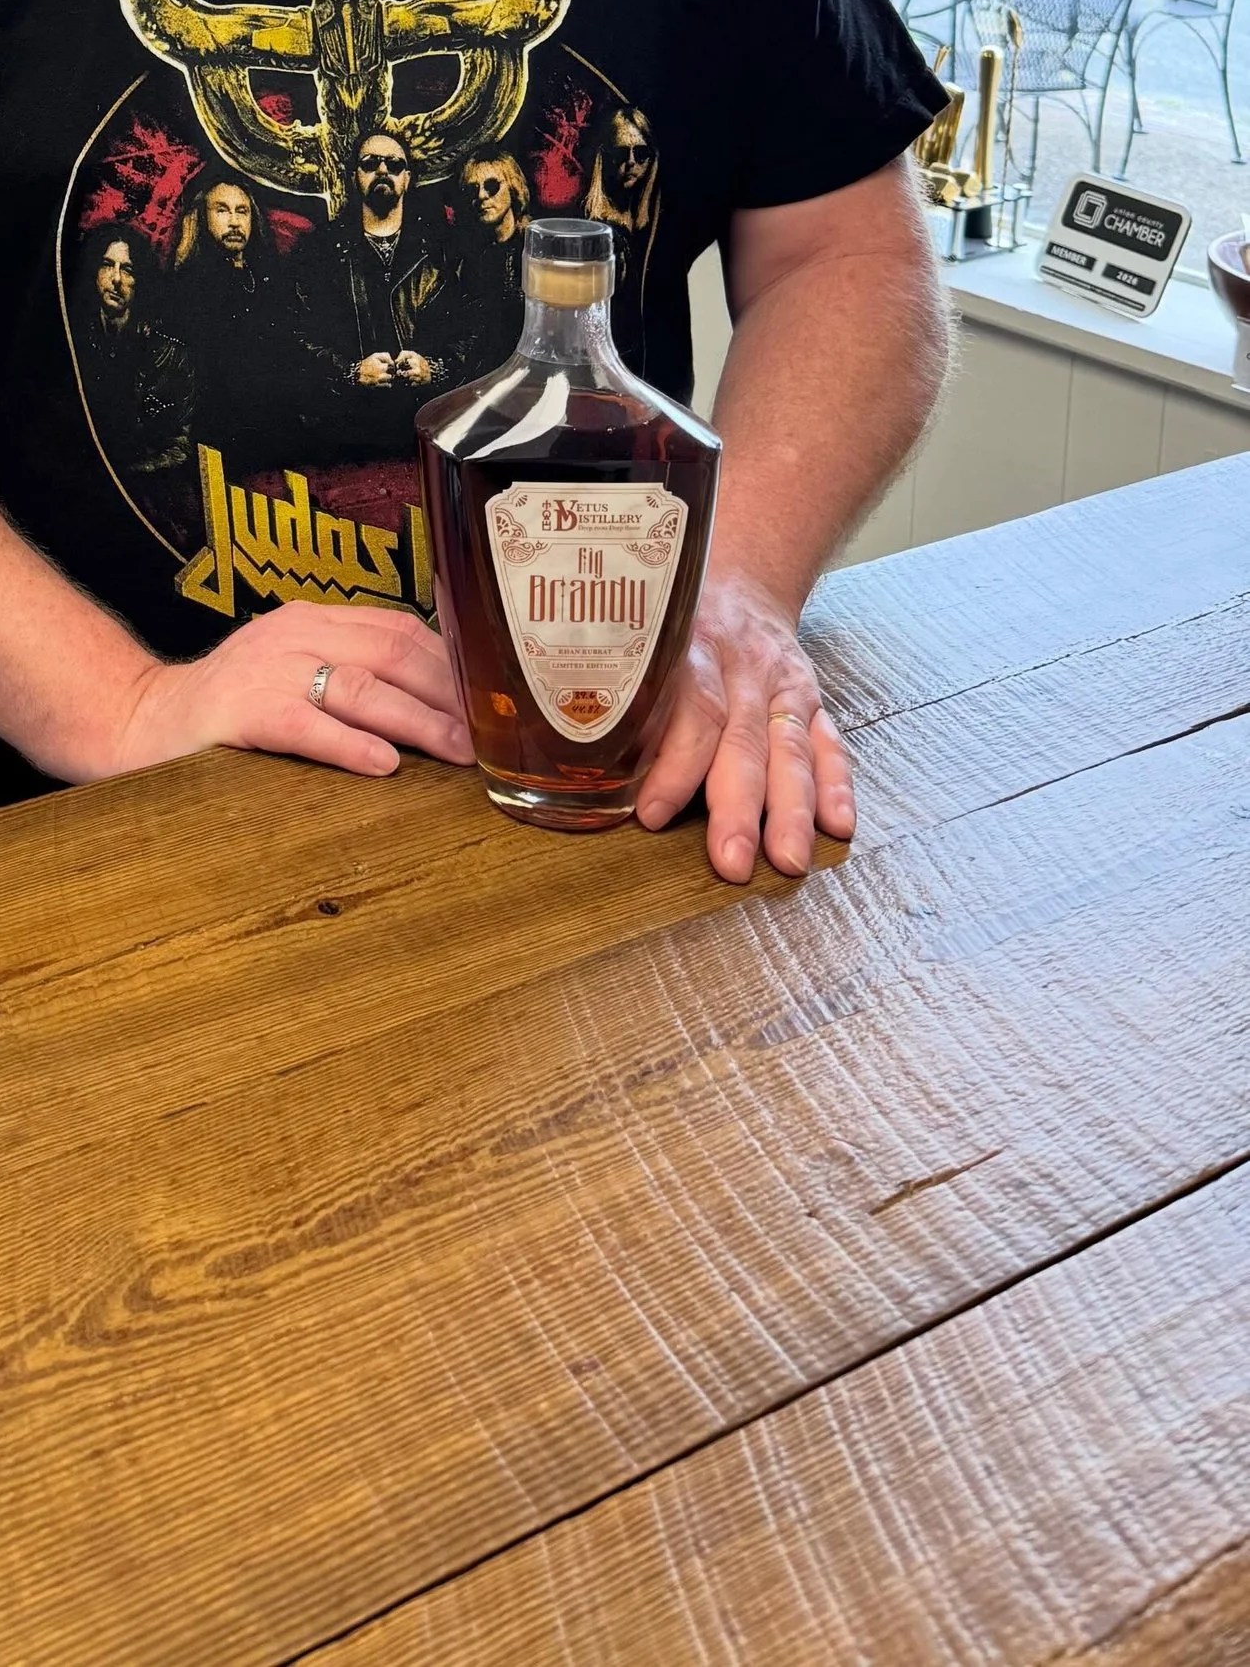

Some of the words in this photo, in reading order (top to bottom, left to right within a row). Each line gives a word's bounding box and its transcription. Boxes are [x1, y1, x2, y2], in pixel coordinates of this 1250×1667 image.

[1103, 214, 1166, 248] CHAMBER
[1050, 245, 1088, 266] MEMBER
[1115, 270, 1139, 286] 2026
[553, 509, 643, 532] DISTILLERY
